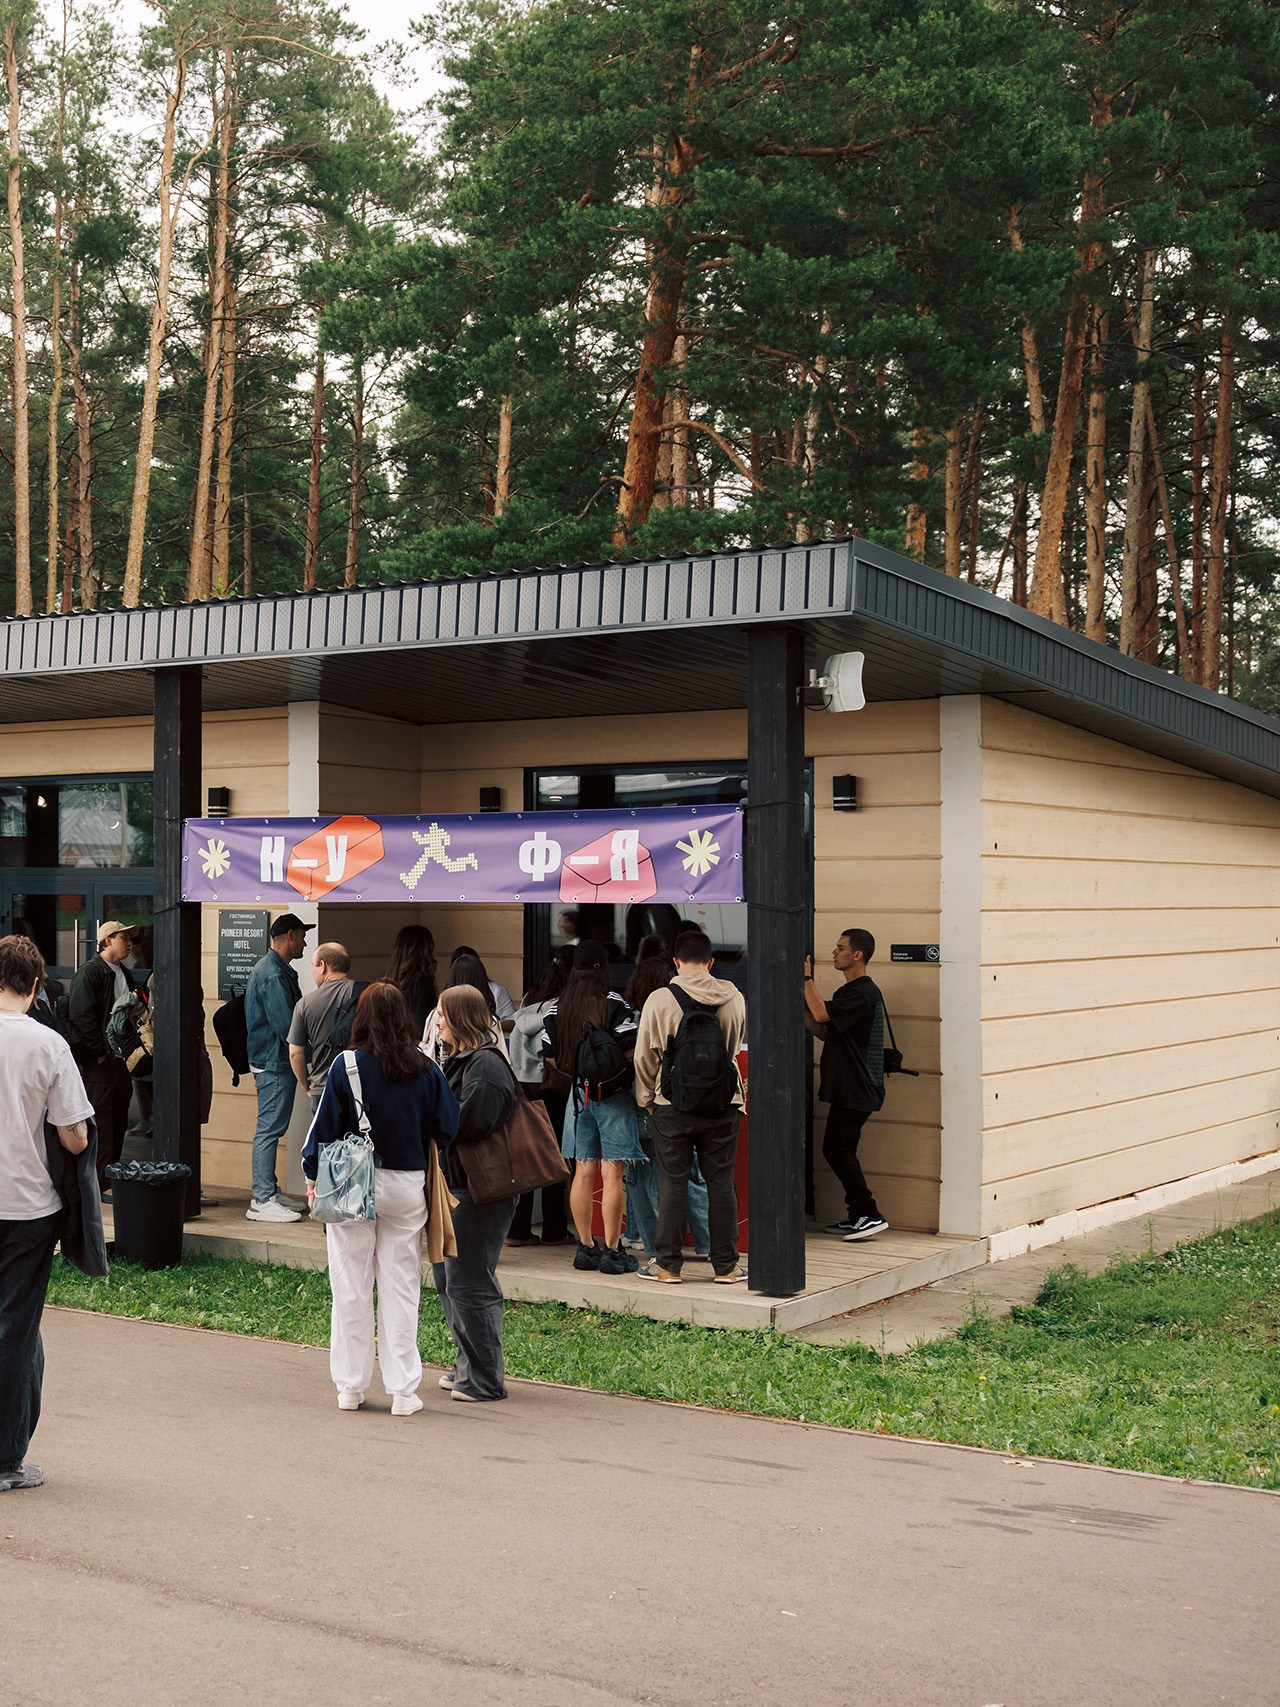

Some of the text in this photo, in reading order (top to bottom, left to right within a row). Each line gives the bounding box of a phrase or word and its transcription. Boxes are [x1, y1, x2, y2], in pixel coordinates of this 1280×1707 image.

[221, 928, 264, 938] PIONEER RESORT
[233, 940, 250, 949] HOTEL
